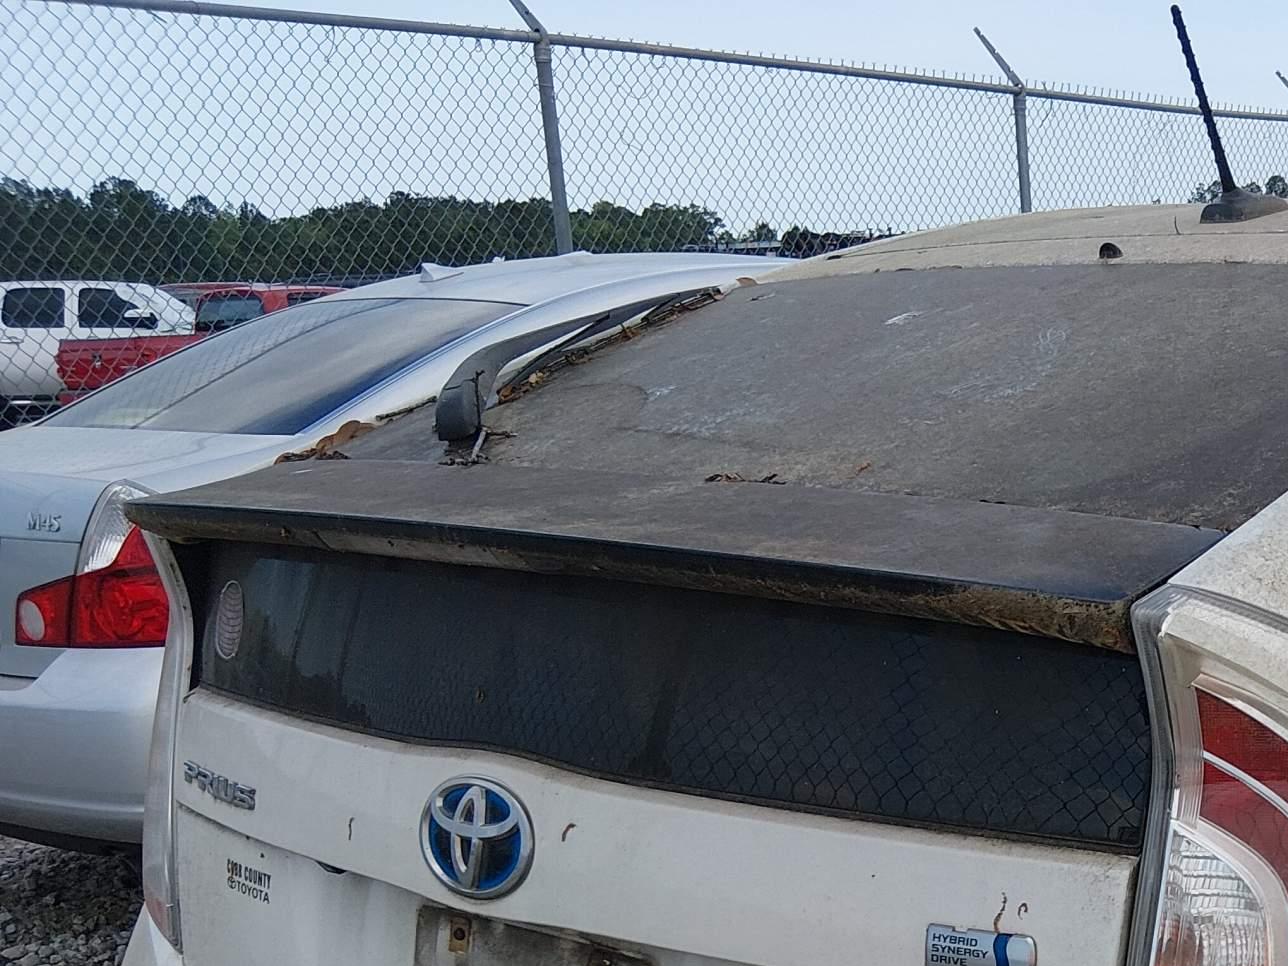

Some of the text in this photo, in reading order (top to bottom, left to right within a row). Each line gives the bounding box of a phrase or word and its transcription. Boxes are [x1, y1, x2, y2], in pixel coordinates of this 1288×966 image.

[27, 512, 62, 532] M45
[184, 760, 256, 810] PRIUS
[244, 866, 271, 890] COUNTY
[237, 880, 270, 904] TOYOTA
[932, 933, 978, 947] HYBRID
[930, 953, 967, 966] DRIVE
[931, 944, 989, 959] SYNERGY
